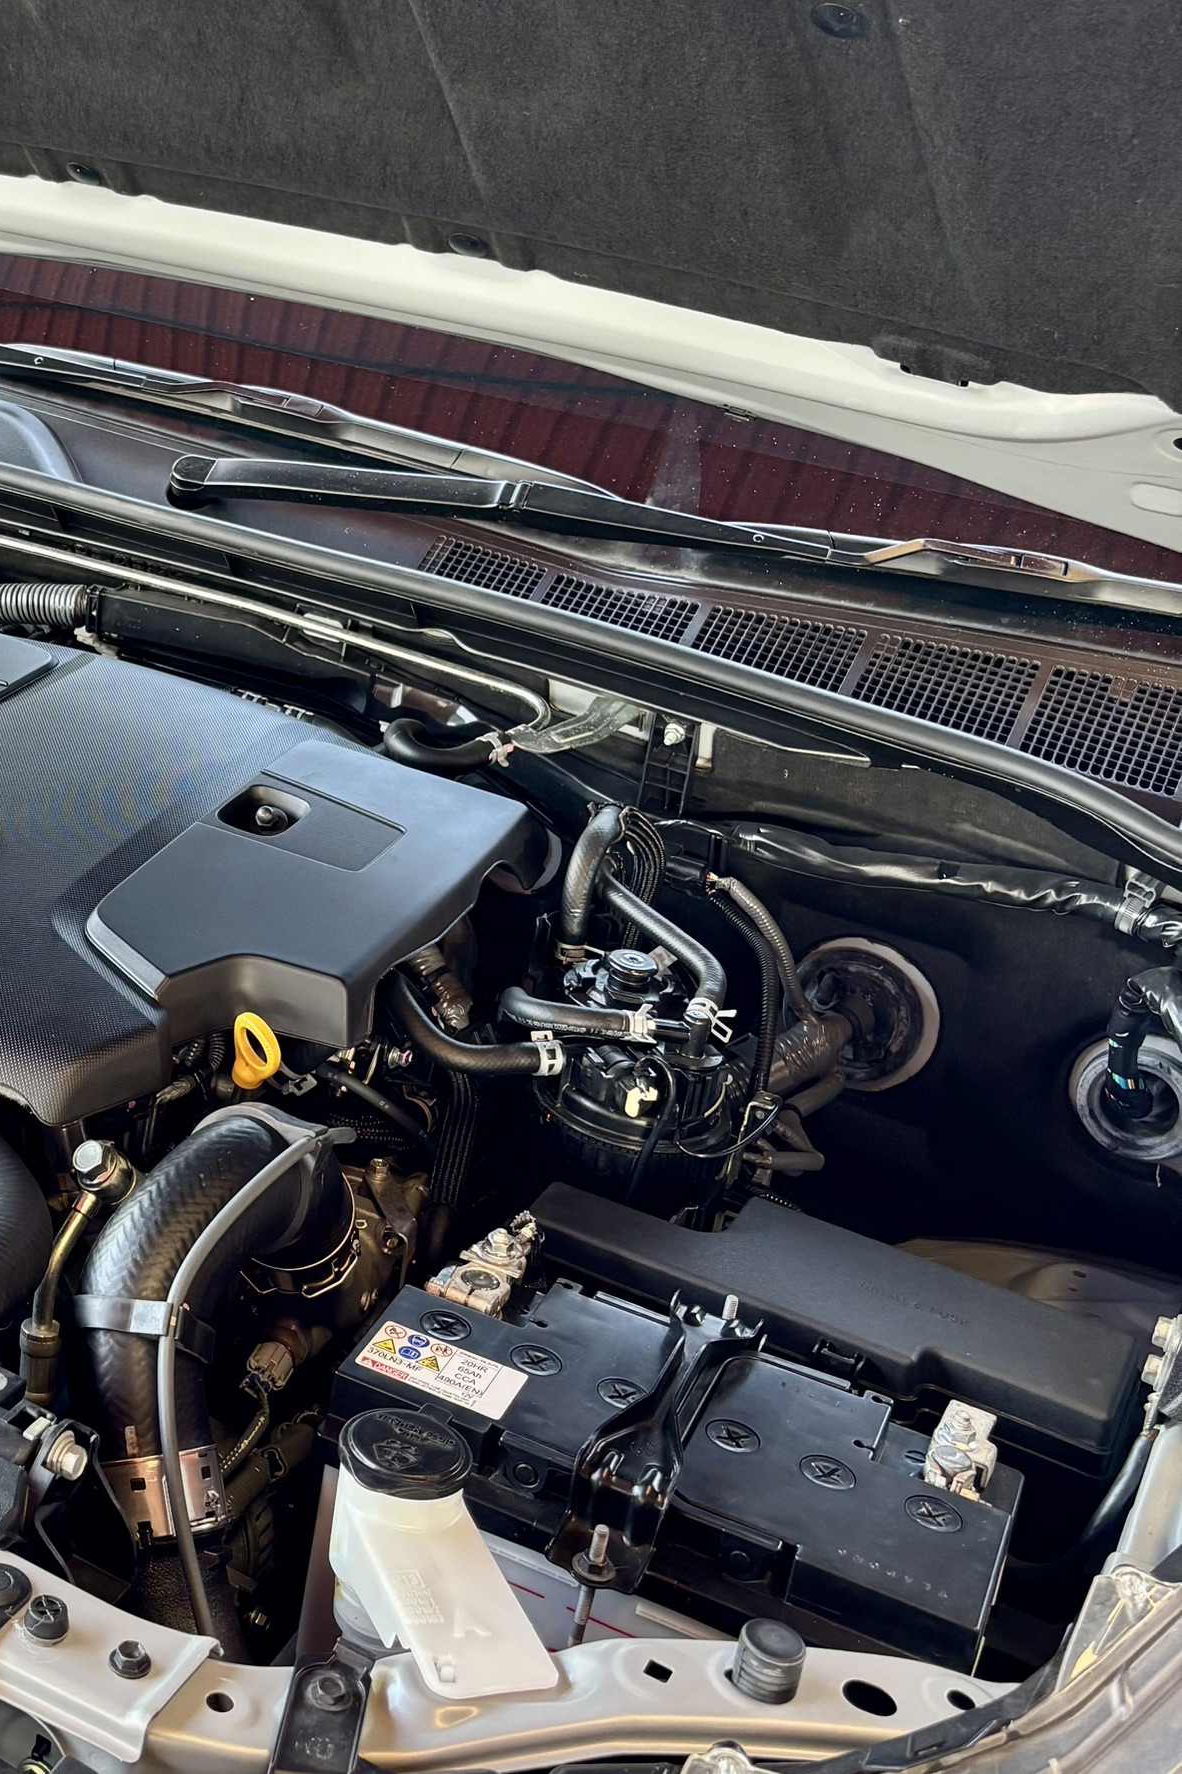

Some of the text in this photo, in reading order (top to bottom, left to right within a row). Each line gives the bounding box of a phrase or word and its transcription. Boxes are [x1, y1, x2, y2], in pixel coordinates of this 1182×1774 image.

[366, 1346, 422, 1373] 370LN3-MF
[461, 1358, 488, 1374] 20HR
[373, 1362, 408, 1381] DANGER
[454, 1373, 476, 1386] CCA
[457, 1365, 482, 1380] 65Ah
[438, 1374, 484, 1397] 490A(EN)
